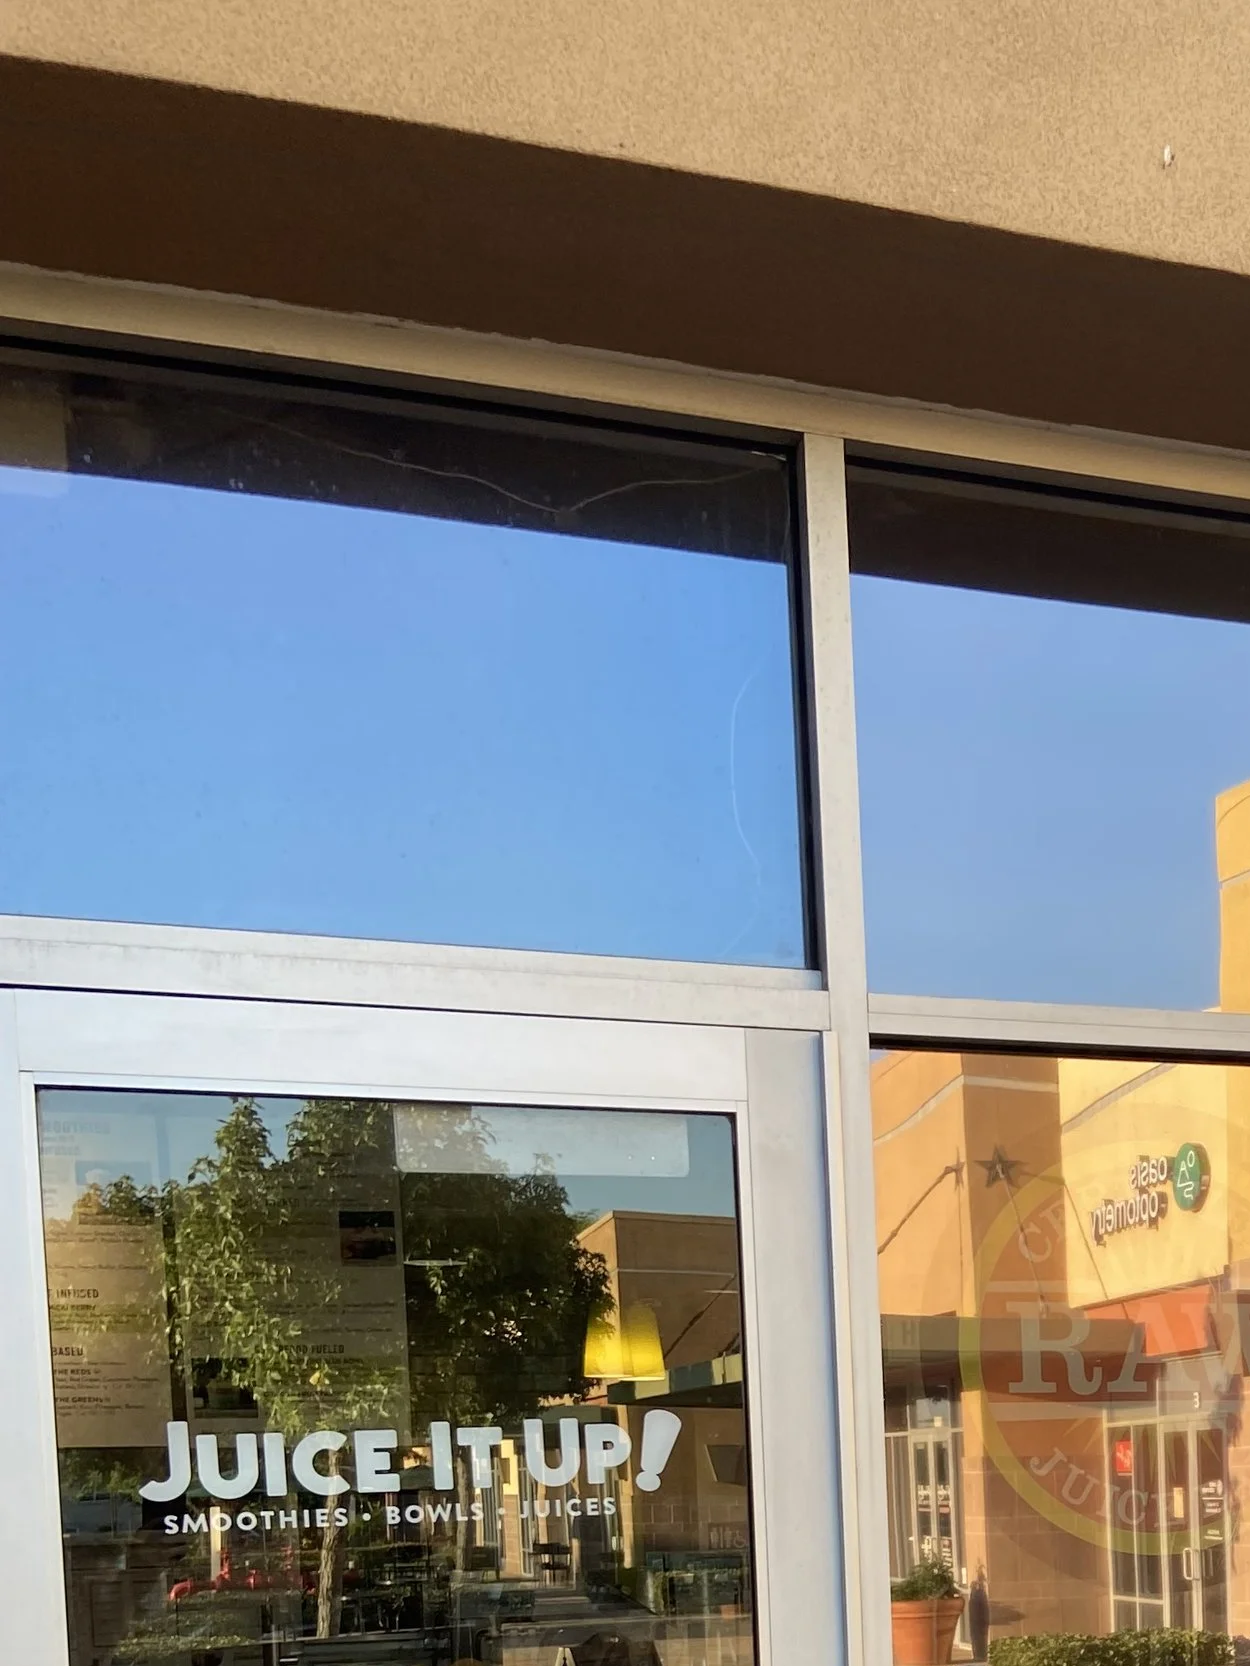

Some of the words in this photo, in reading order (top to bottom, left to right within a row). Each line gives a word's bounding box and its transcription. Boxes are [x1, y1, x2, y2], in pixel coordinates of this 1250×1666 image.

[139, 1420, 400, 1502] JUICE
[430, 1418, 502, 1491] IT
[523, 1408, 682, 1492] UP!
[164, 1506, 348, 1535] SMOOTHIES
[386, 1501, 485, 1526] BOWLS
[519, 1496, 617, 1519] JUICES
